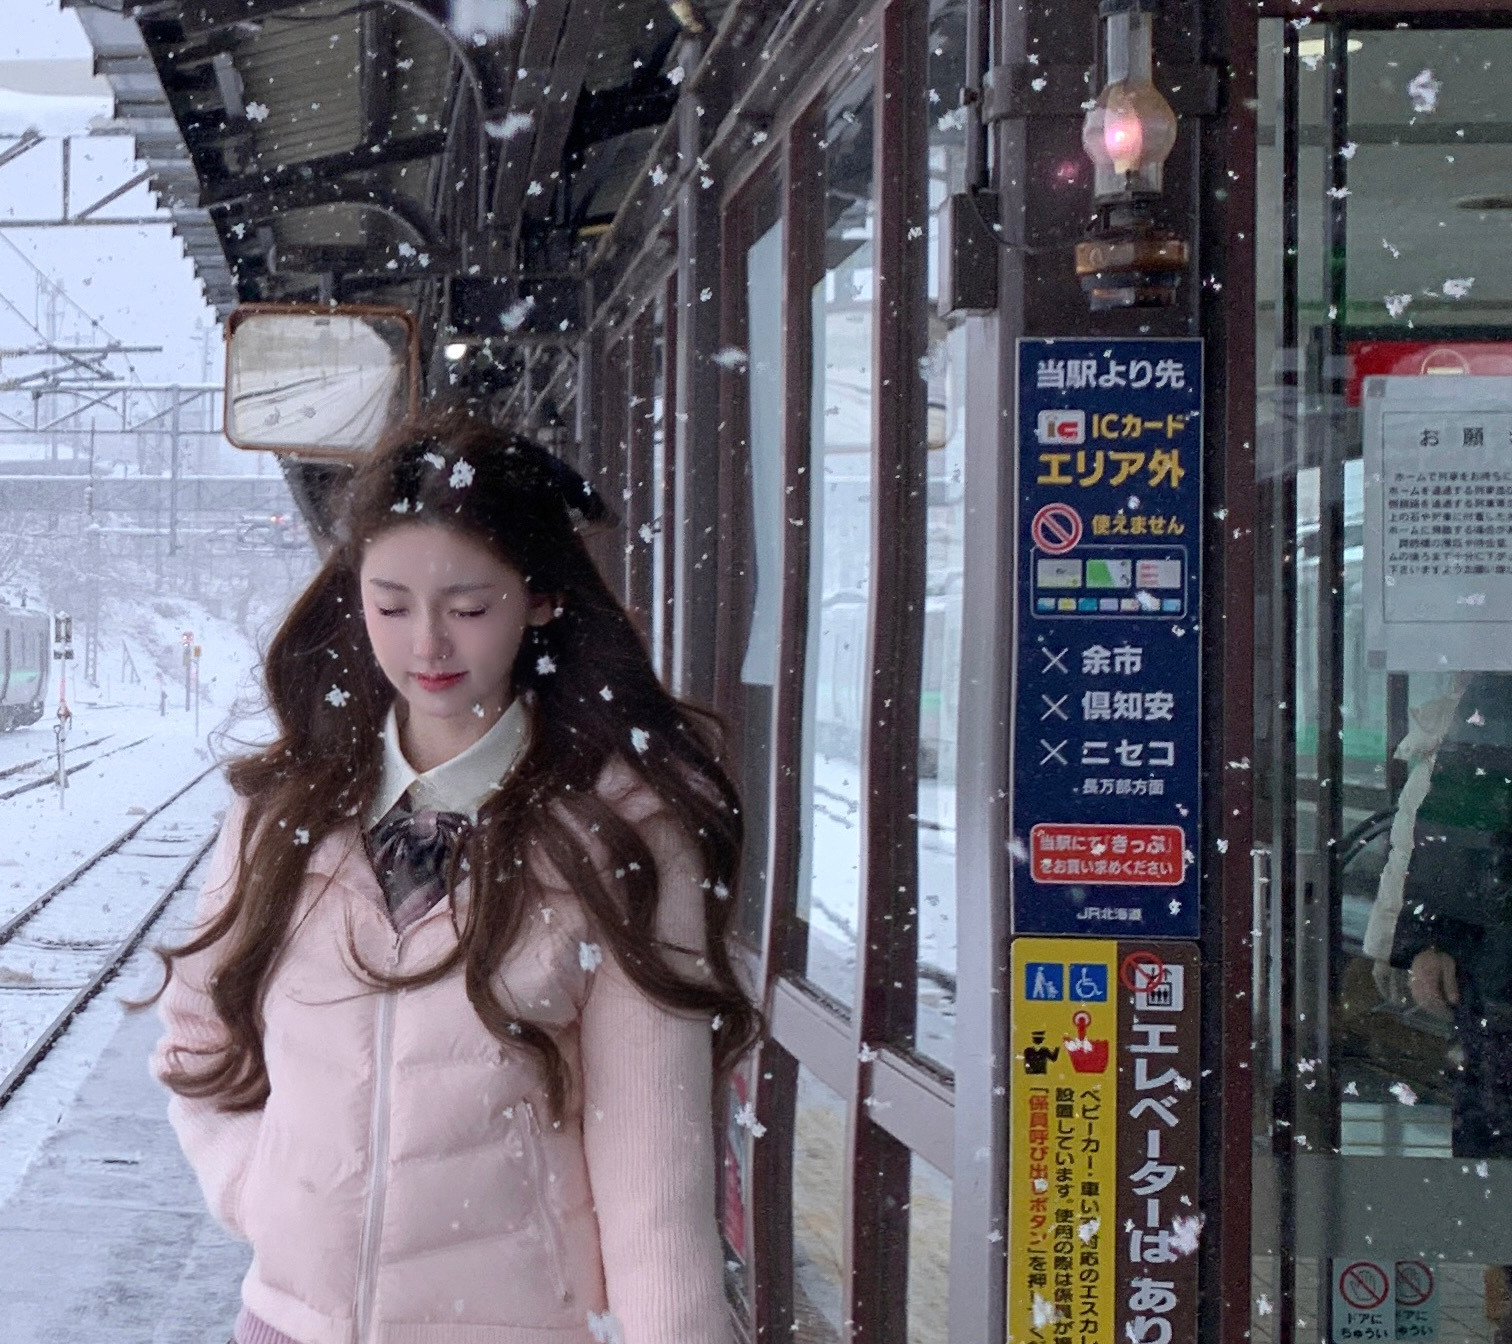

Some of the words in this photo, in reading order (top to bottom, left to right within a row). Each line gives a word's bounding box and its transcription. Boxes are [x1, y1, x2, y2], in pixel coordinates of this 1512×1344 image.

[1037, 358, 1185, 388] 当駅より先
[1092, 413, 1185, 439] ICカード
[1037, 448, 1185, 488] エリア外
[1092, 513, 1185, 536] 使えません
[1082, 644, 1143, 675] 余市
[1081, 691, 1175, 721] 倶知安
[1081, 739, 1175, 767] ニセコ
[1082, 778, 1164, 795] 長万部方面
[1076, 907, 1142, 921] JR北海道
